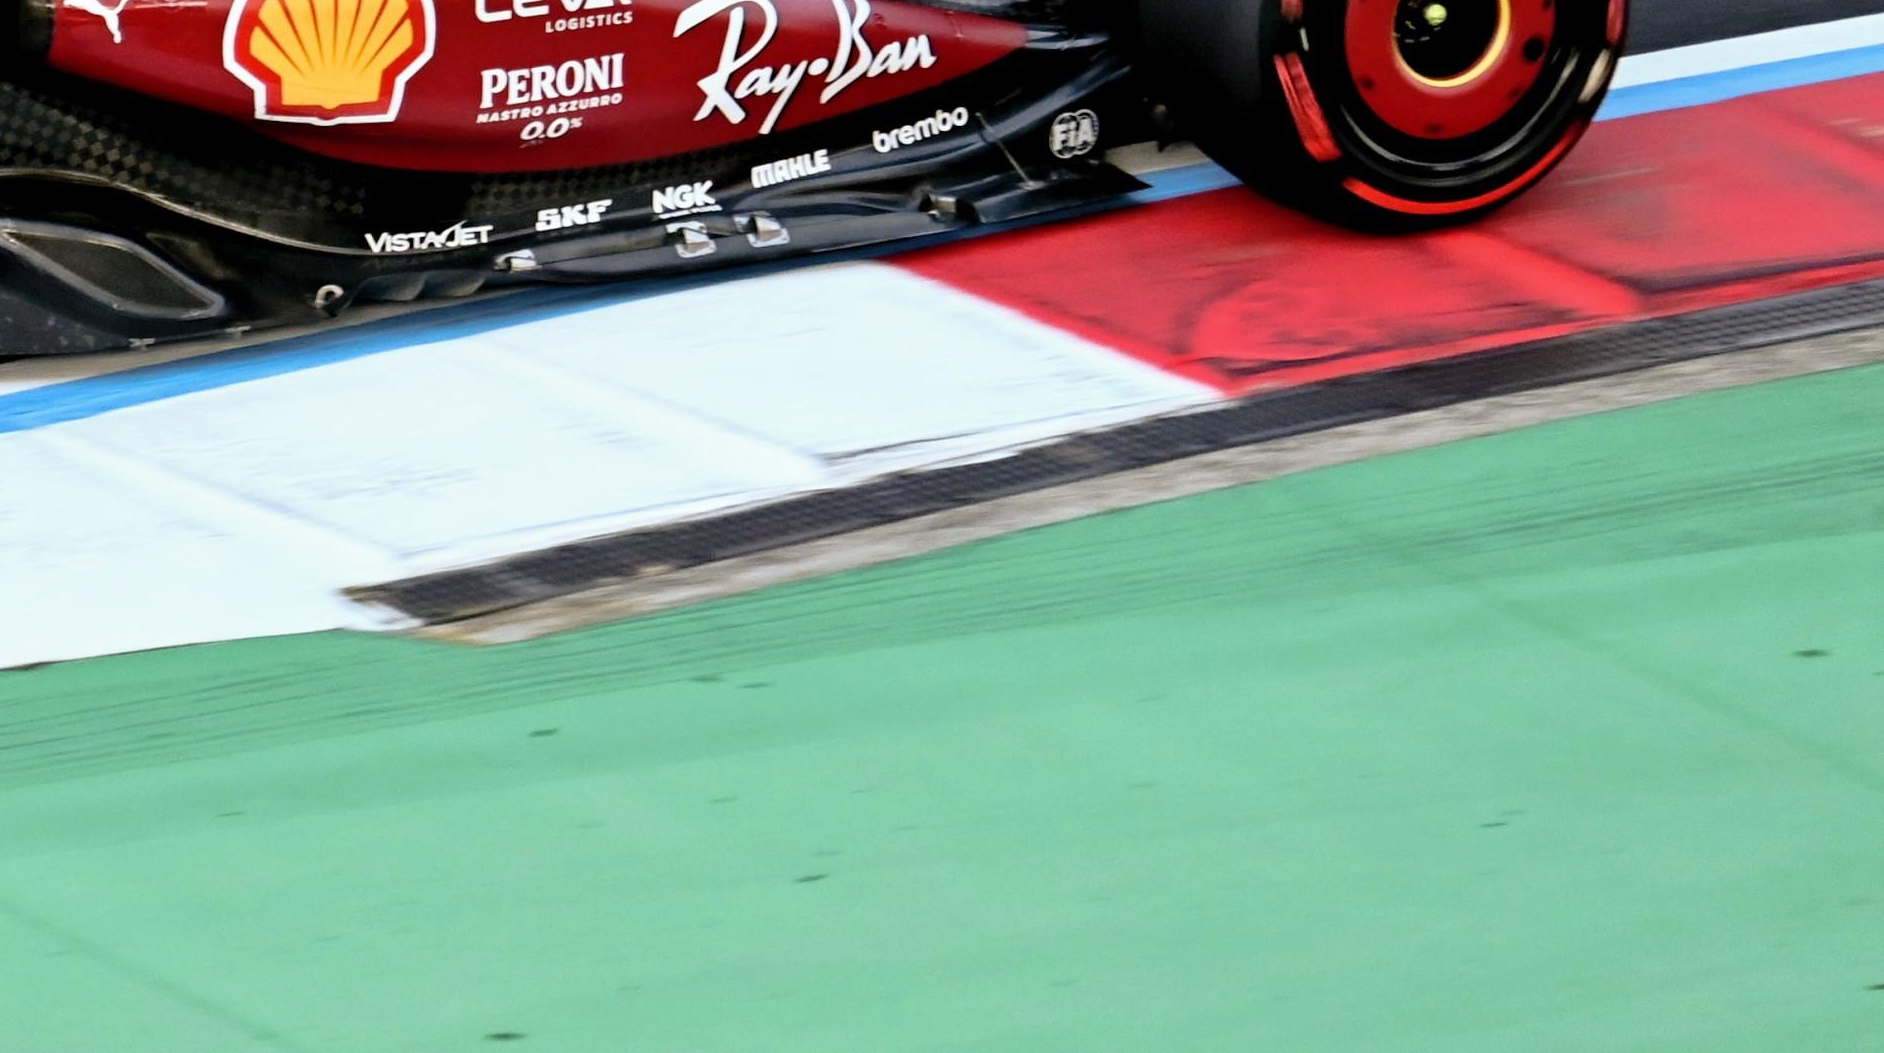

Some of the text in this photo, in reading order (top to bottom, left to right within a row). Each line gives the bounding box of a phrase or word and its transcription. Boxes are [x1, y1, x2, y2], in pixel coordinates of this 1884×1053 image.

[545, 11, 634, 34] LOGISTICS
[479, 52, 626, 110] PERONI
[476, 93, 624, 124] NASTRO AZZURRO
[872, 107, 969, 154] brembo
[751, 149, 832, 189] MAHLE
[652, 179, 717, 214] NGK
[535, 199, 613, 232] SKF
